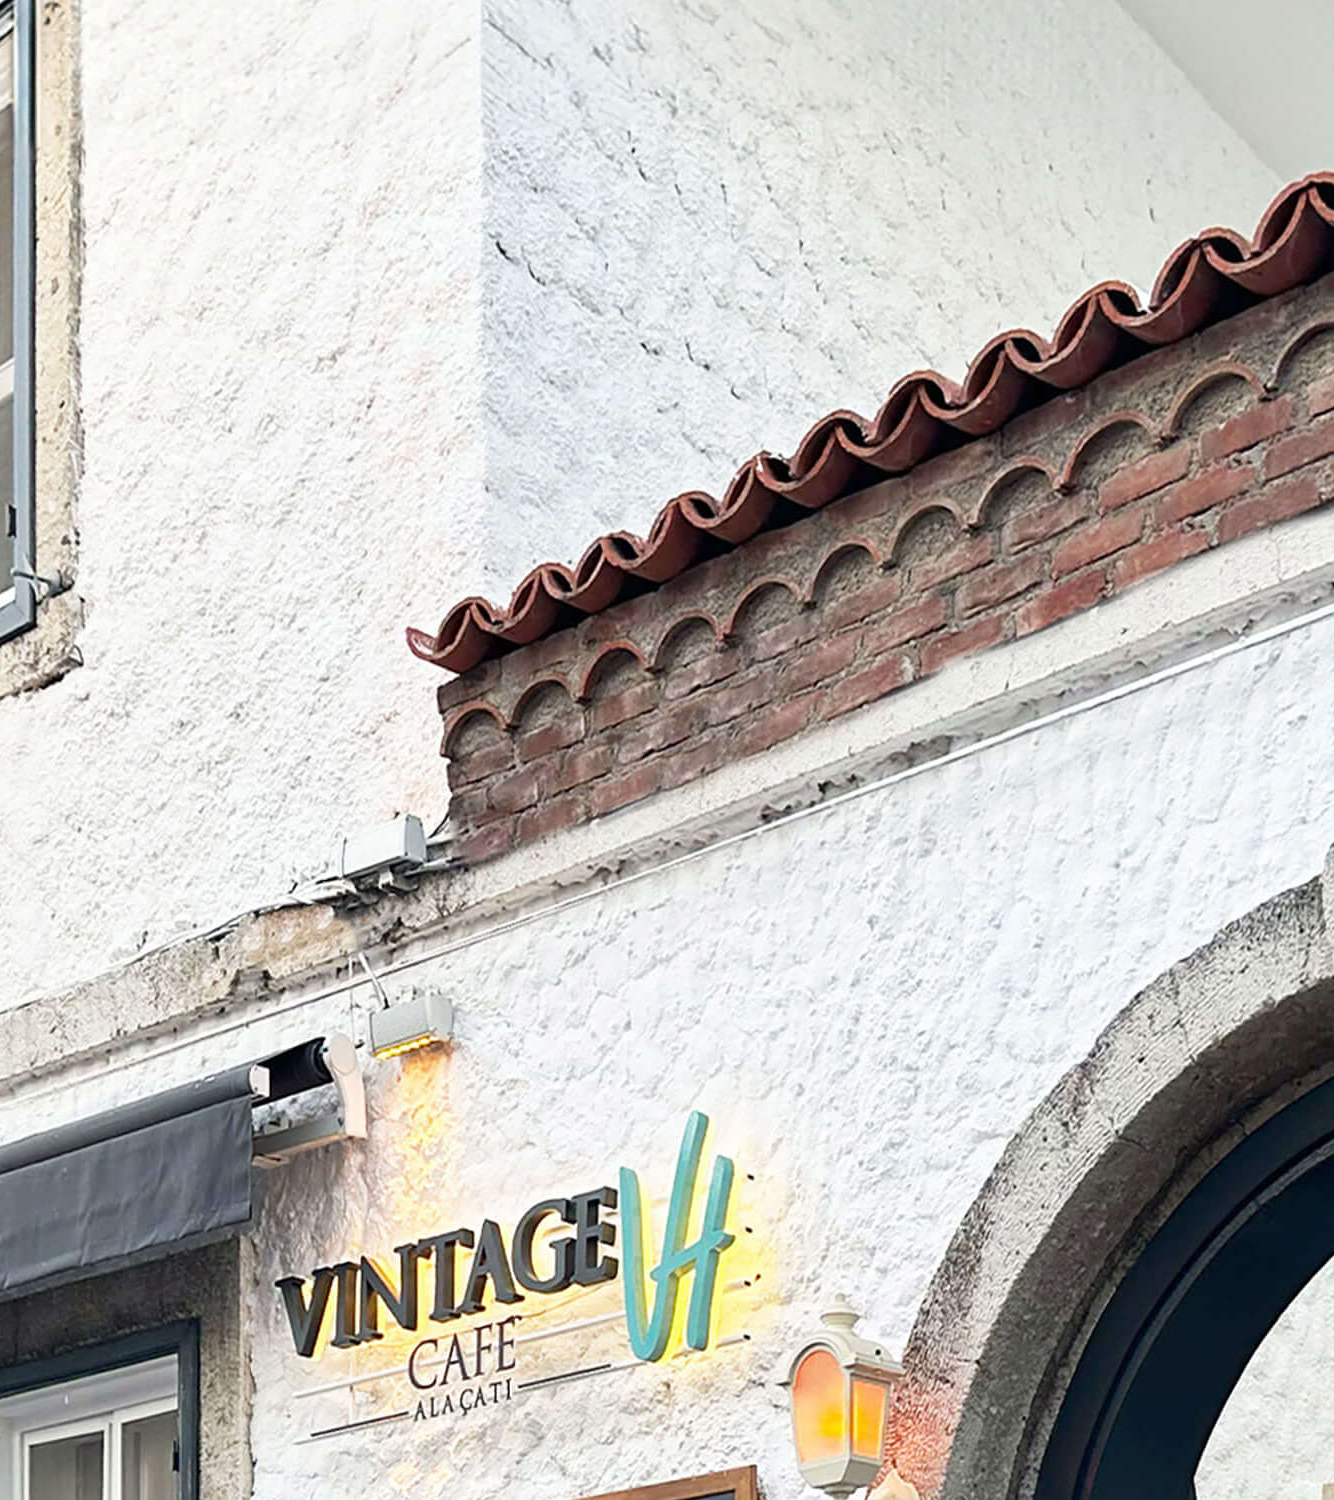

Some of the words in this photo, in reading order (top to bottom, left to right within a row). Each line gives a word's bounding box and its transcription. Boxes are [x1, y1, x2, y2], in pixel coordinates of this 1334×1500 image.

[275, 1186, 618, 1357] VINTAGE
[408, 1316, 523, 1390] CAFE
[413, 1378, 513, 1421] ALAÇATI
